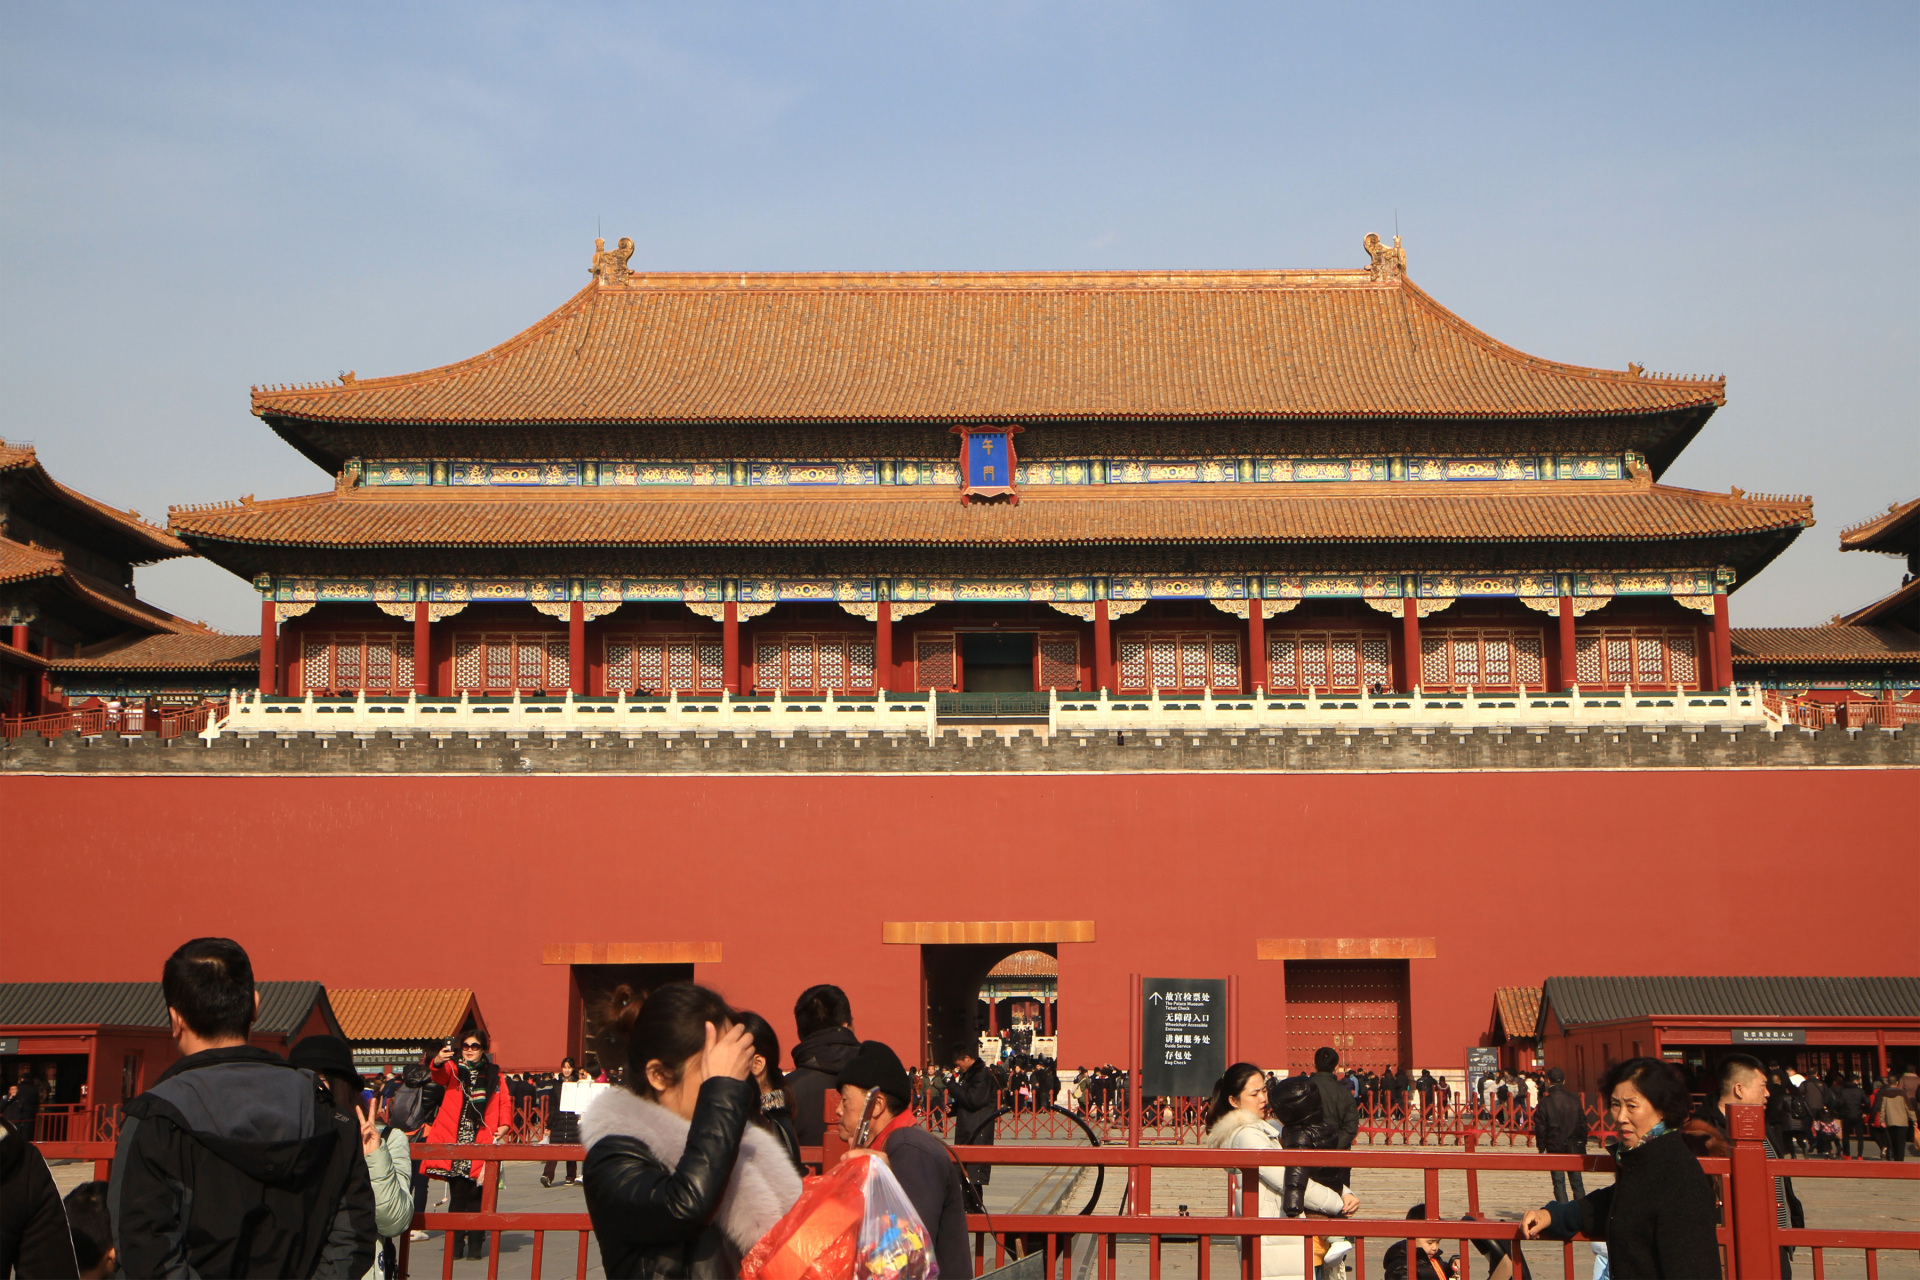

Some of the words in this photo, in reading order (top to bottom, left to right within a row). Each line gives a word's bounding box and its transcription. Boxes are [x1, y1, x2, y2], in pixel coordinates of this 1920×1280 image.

[982, 439, 995, 481] 午門
[1165, 992, 1210, 1002] 故宫检票处
[1165, 1013, 1210, 1022] 无障碍入口
[1165, 1034, 1210, 1044] 讲解服务处
[409, 1046, 423, 1054] Guide
[1165, 1051, 1192, 1060] 存包处
